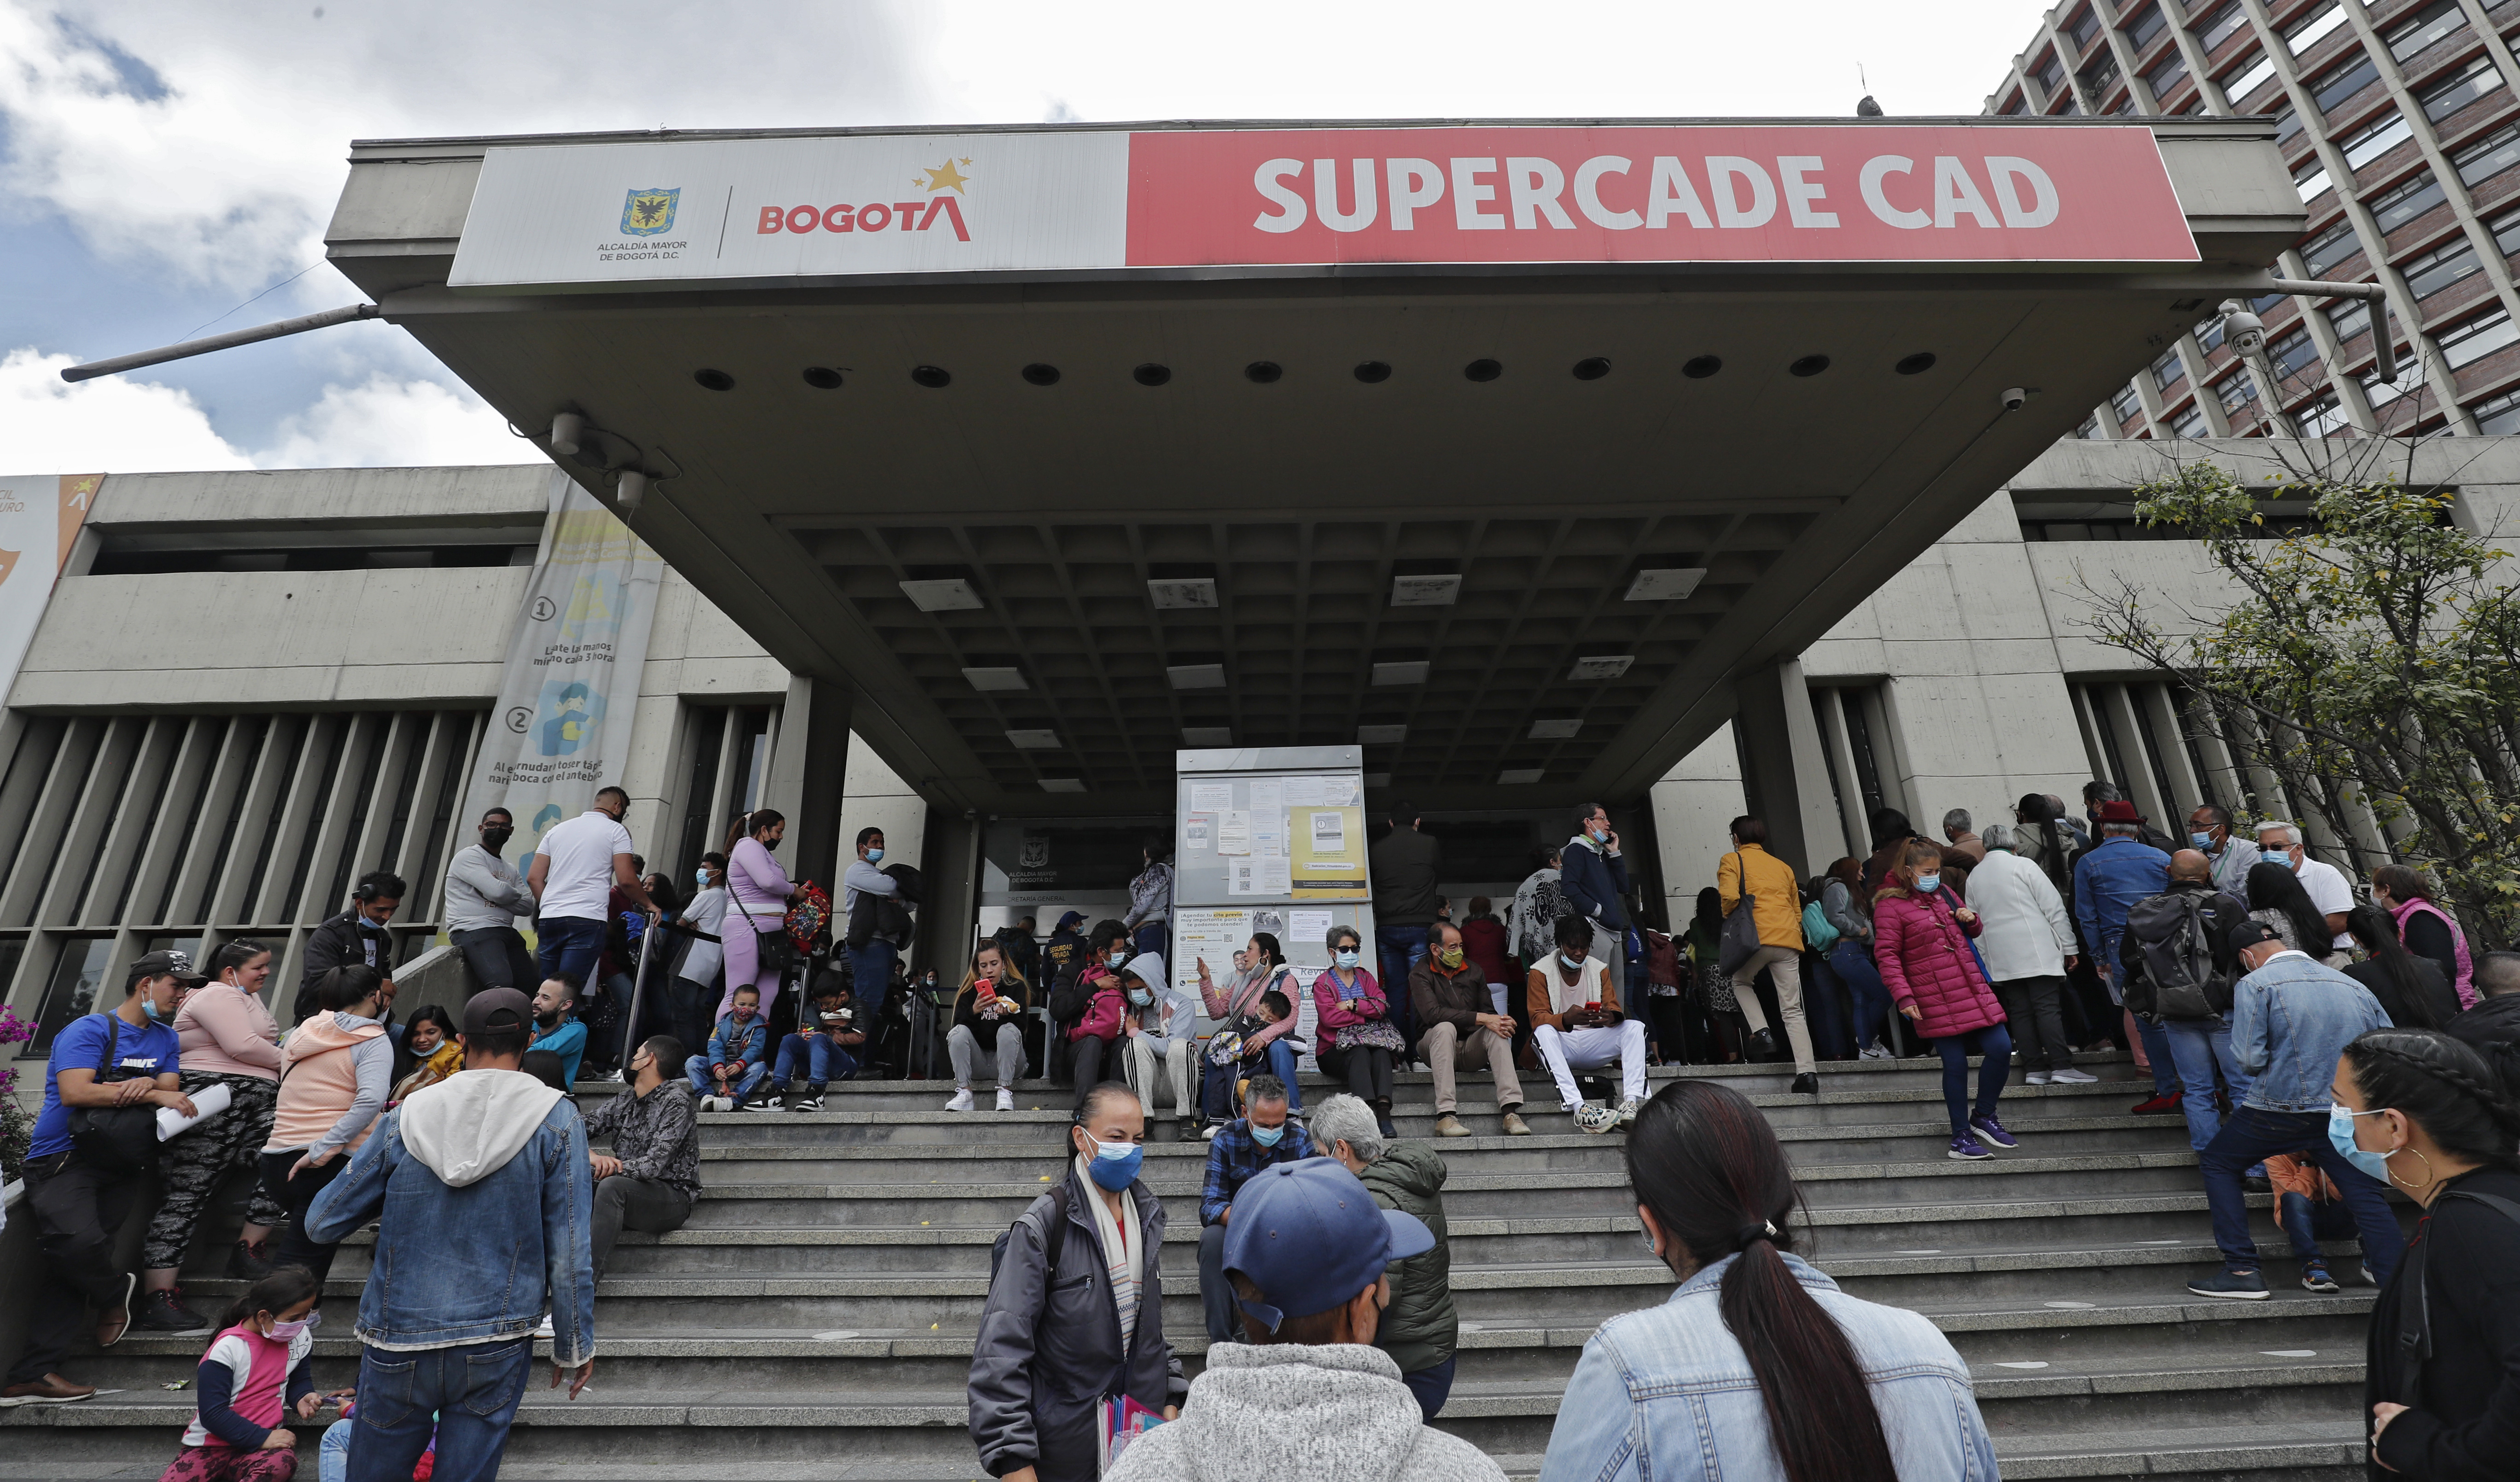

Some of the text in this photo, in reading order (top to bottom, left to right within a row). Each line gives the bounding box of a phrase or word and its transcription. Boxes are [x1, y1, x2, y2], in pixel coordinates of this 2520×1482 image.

[1252, 154, 2060, 234] SUPERCADE CAD
[597, 240, 687, 251] ALCALDÍA MAYOR
[615, 250, 659, 261] BOGOTÁ
[536, 601, 546, 617] 1
[583, 643, 612, 651] manos
[585, 653, 591, 662] 3
[514, 712, 526, 728] 2
[493, 762, 505, 772] Al
[558, 761, 581, 769] toser
[512, 773, 539, 783] boca
[556, 771, 565, 780] el
[1049, 944, 1073, 953] SEGURIDAD
[1052, 950, 1070, 959] PRIVADA
[120, 1057, 158, 1068] NIKE
